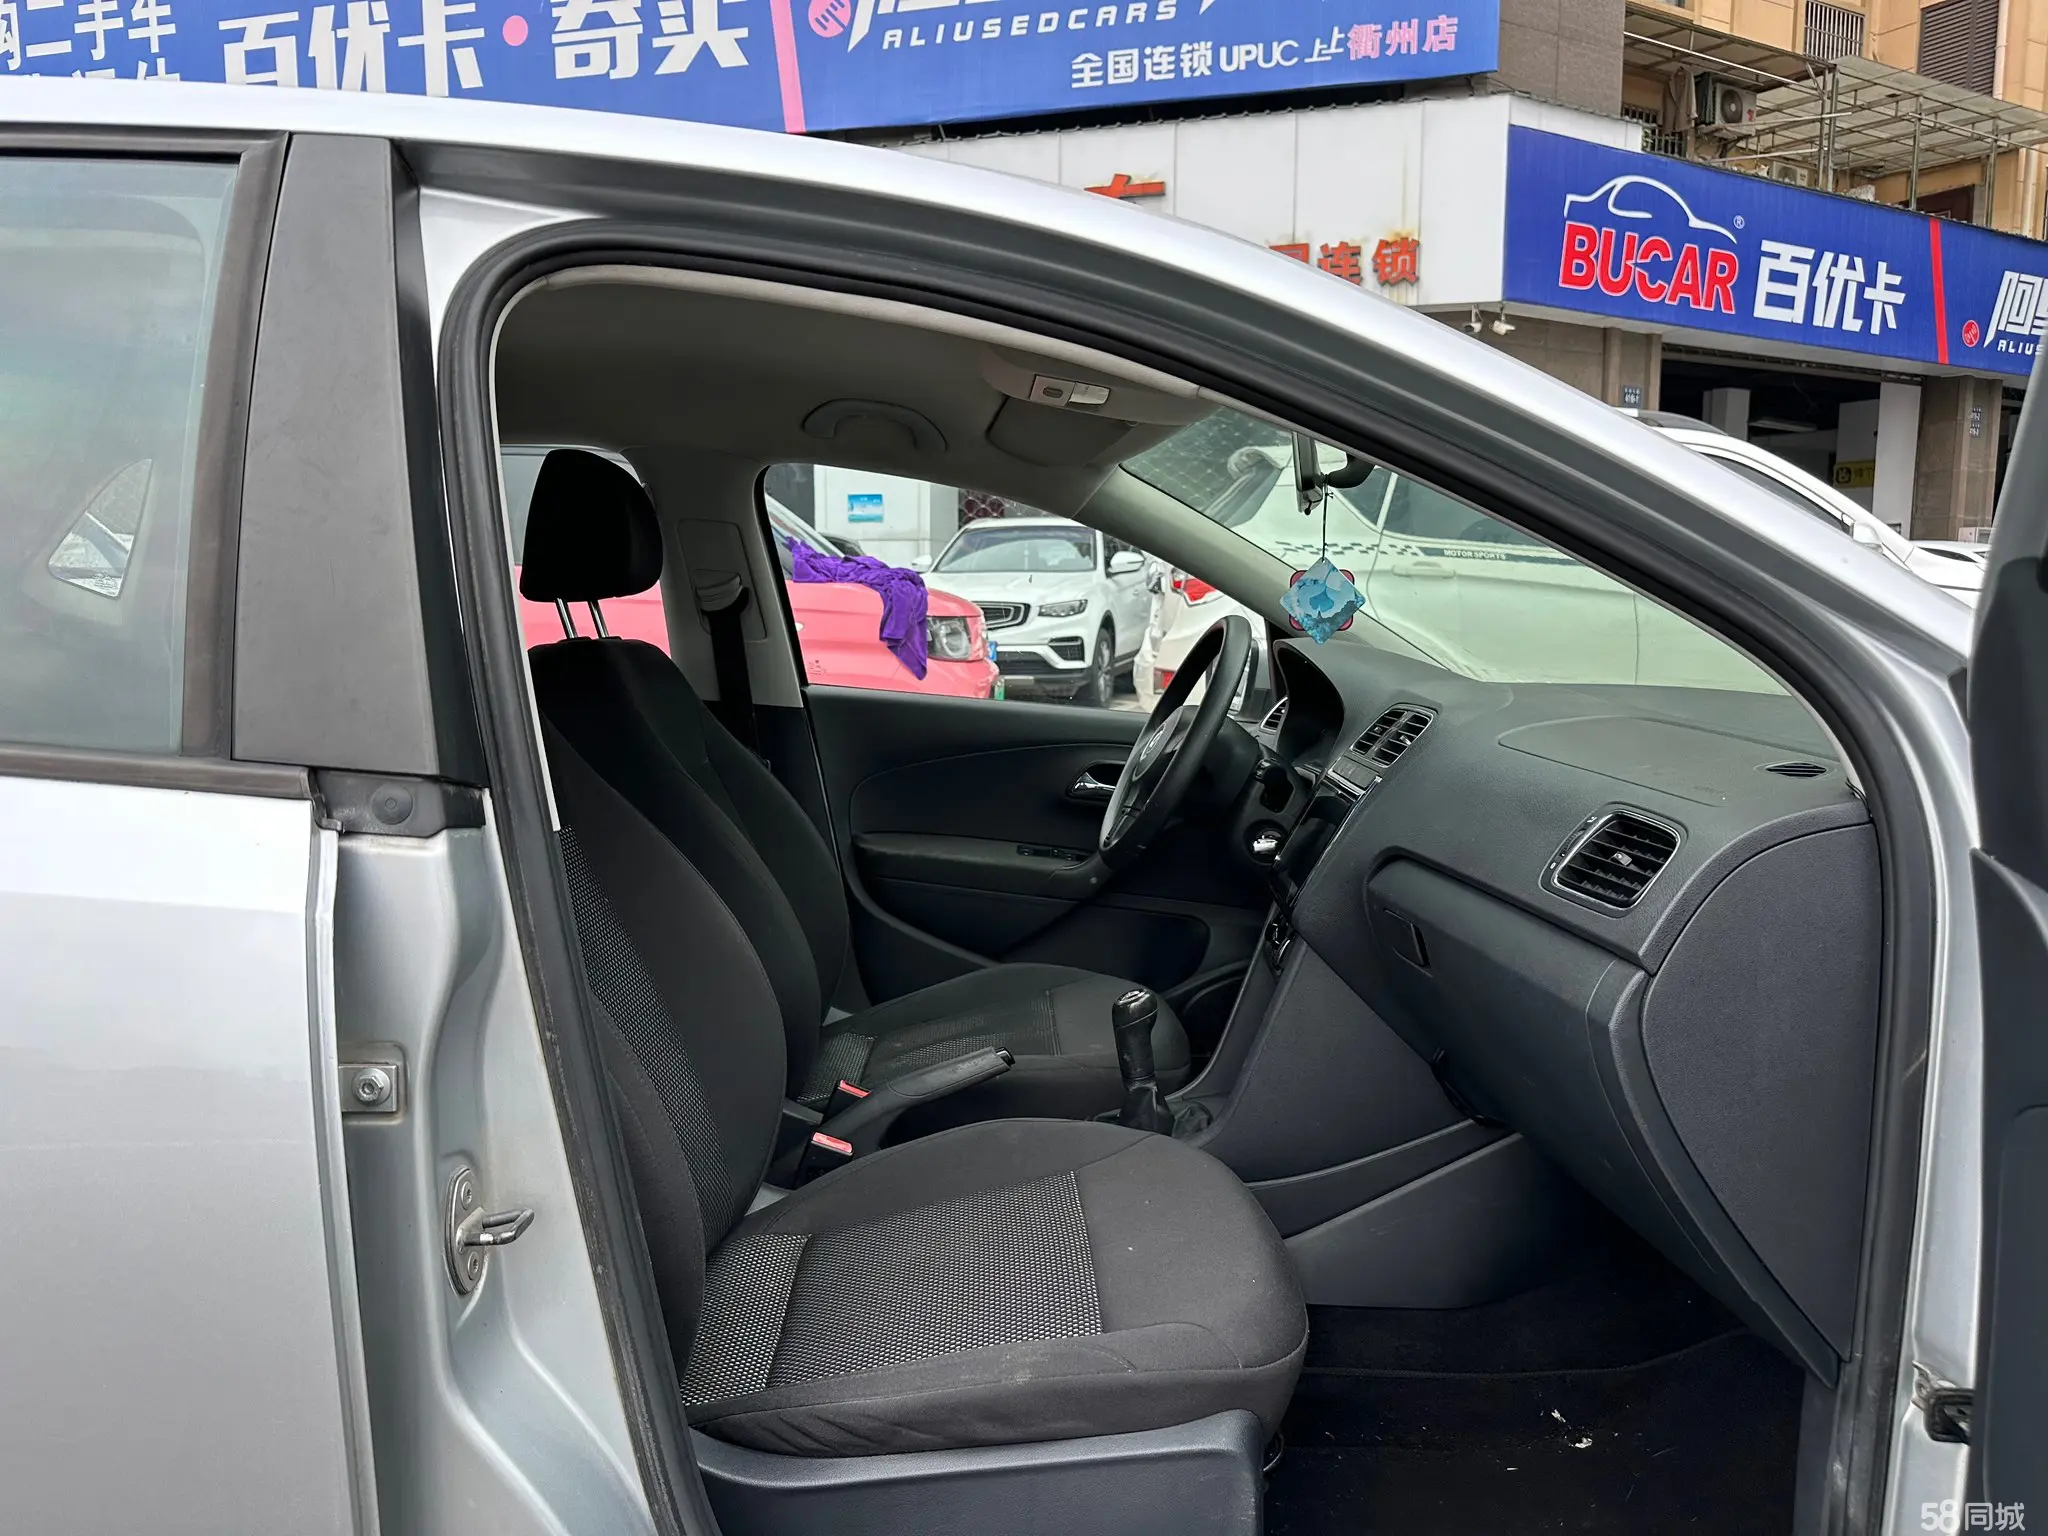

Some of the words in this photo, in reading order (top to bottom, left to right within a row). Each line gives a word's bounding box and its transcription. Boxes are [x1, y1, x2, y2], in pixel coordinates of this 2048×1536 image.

[1071, 41, 1213, 88] 全国连锁
[1219, 39, 1299, 73] UPUC
[1347, 14, 1458, 60] 衢州店
[1559, 220, 1738, 314] BUCAR
[1753, 239, 1906, 335] 百优卡
[1443, 549, 1473, 559] MOTOR
[1473, 551, 1506, 561] SPORTS
